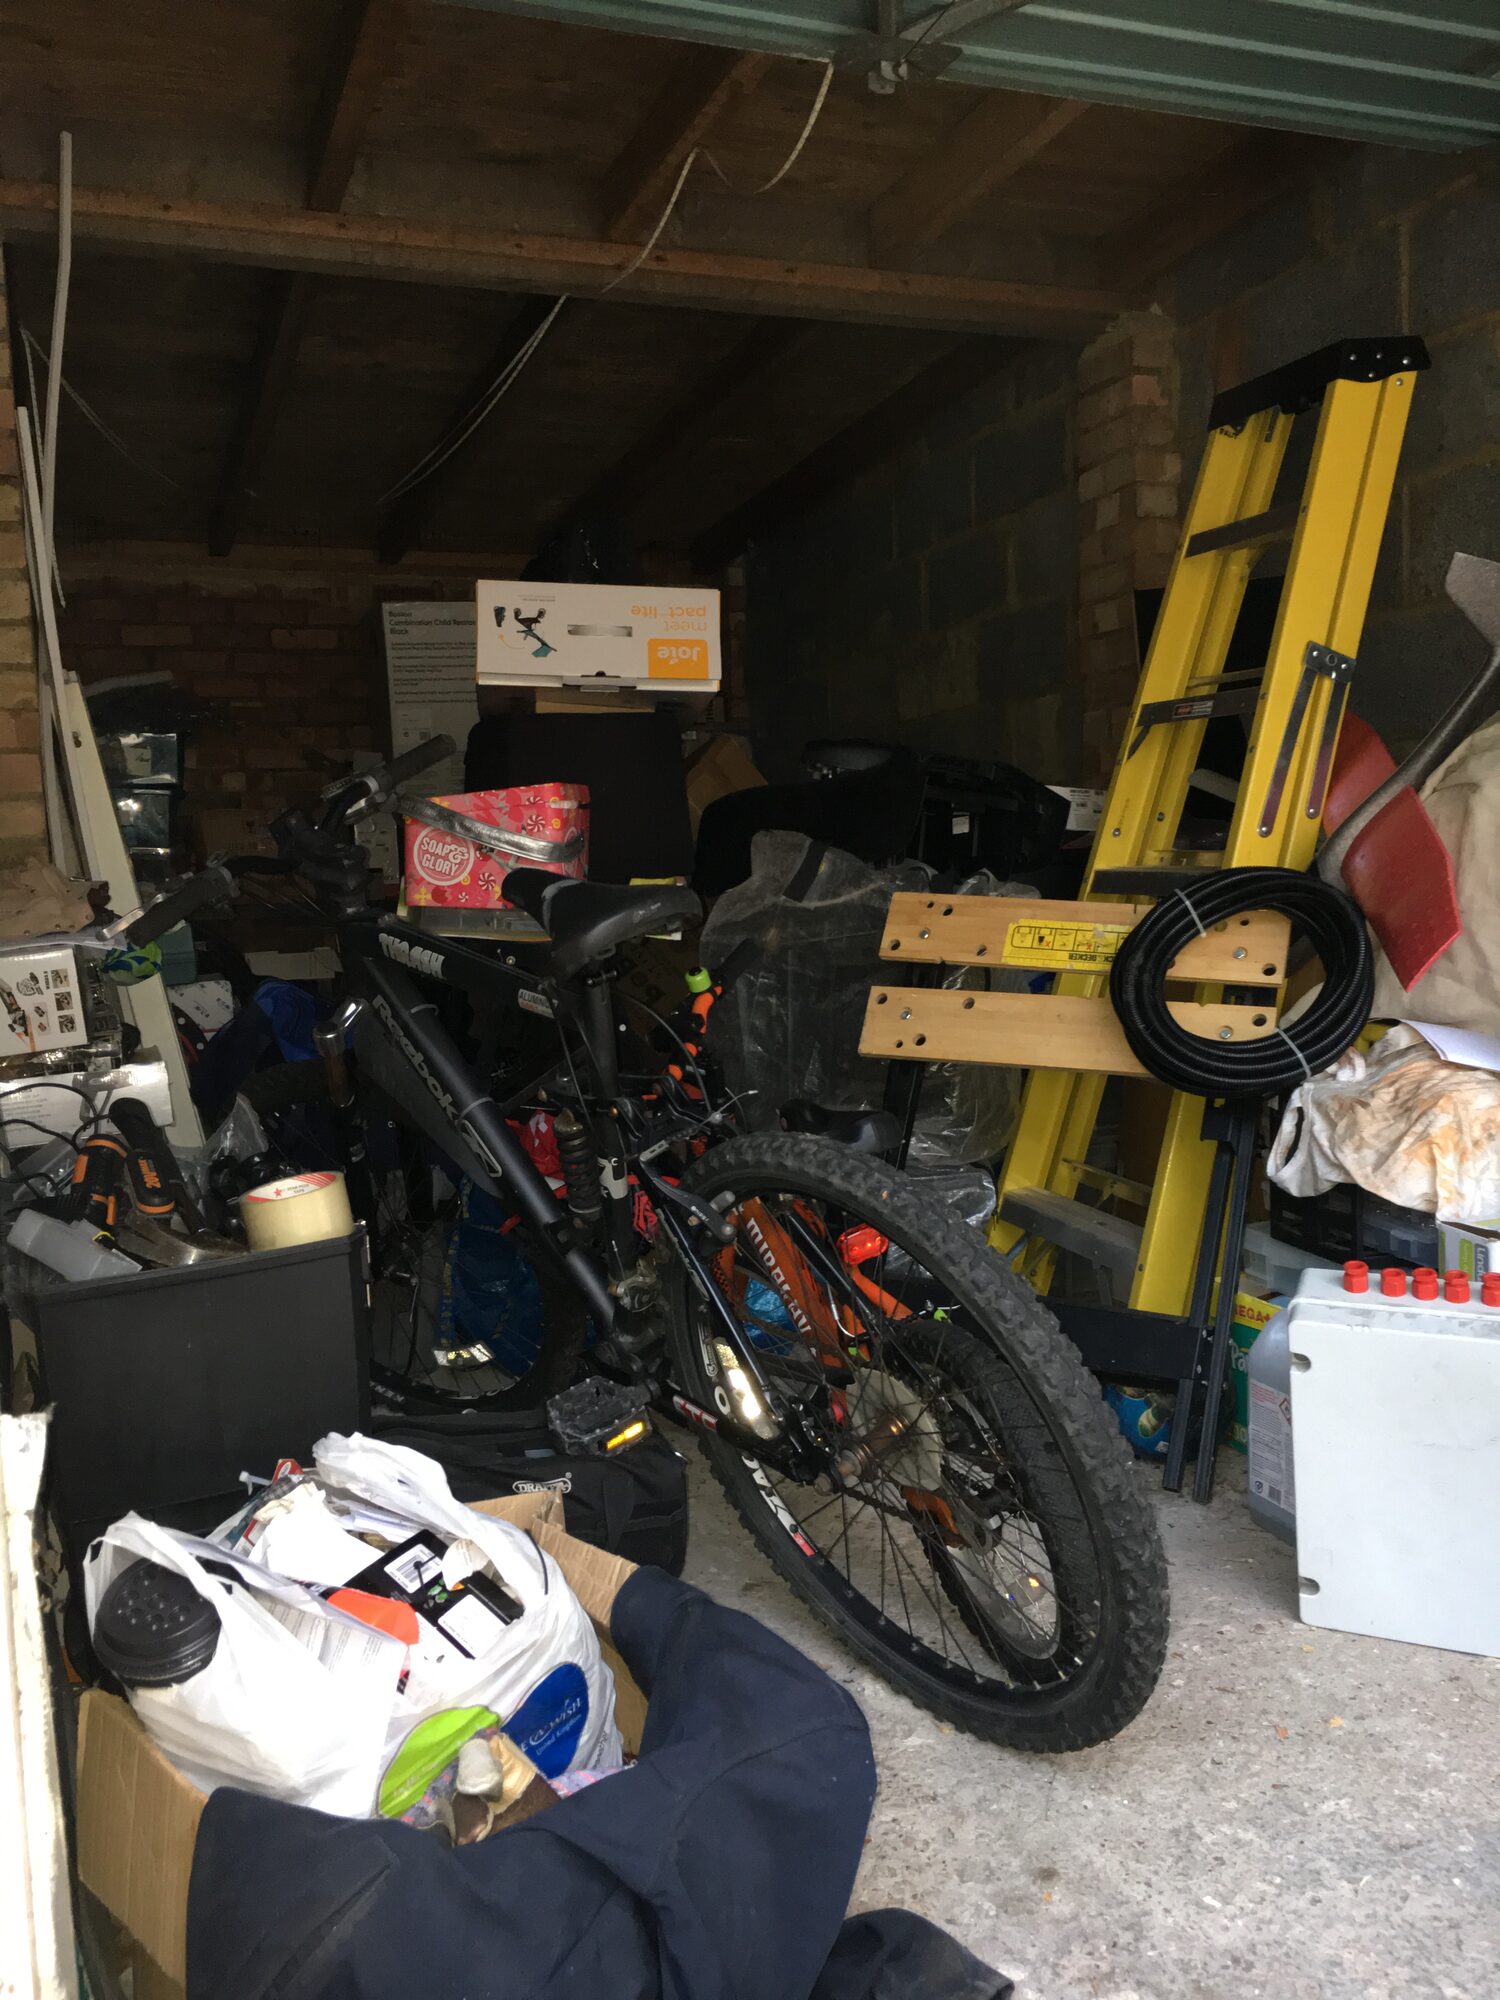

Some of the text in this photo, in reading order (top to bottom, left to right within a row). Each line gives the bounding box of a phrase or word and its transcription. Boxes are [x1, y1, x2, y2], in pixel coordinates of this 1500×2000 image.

[657, 645, 701, 665] Joie
[421, 837, 450, 856] SOAP
[421, 853, 459, 876] GLORY
[372, 994, 461, 1121] Reebok
